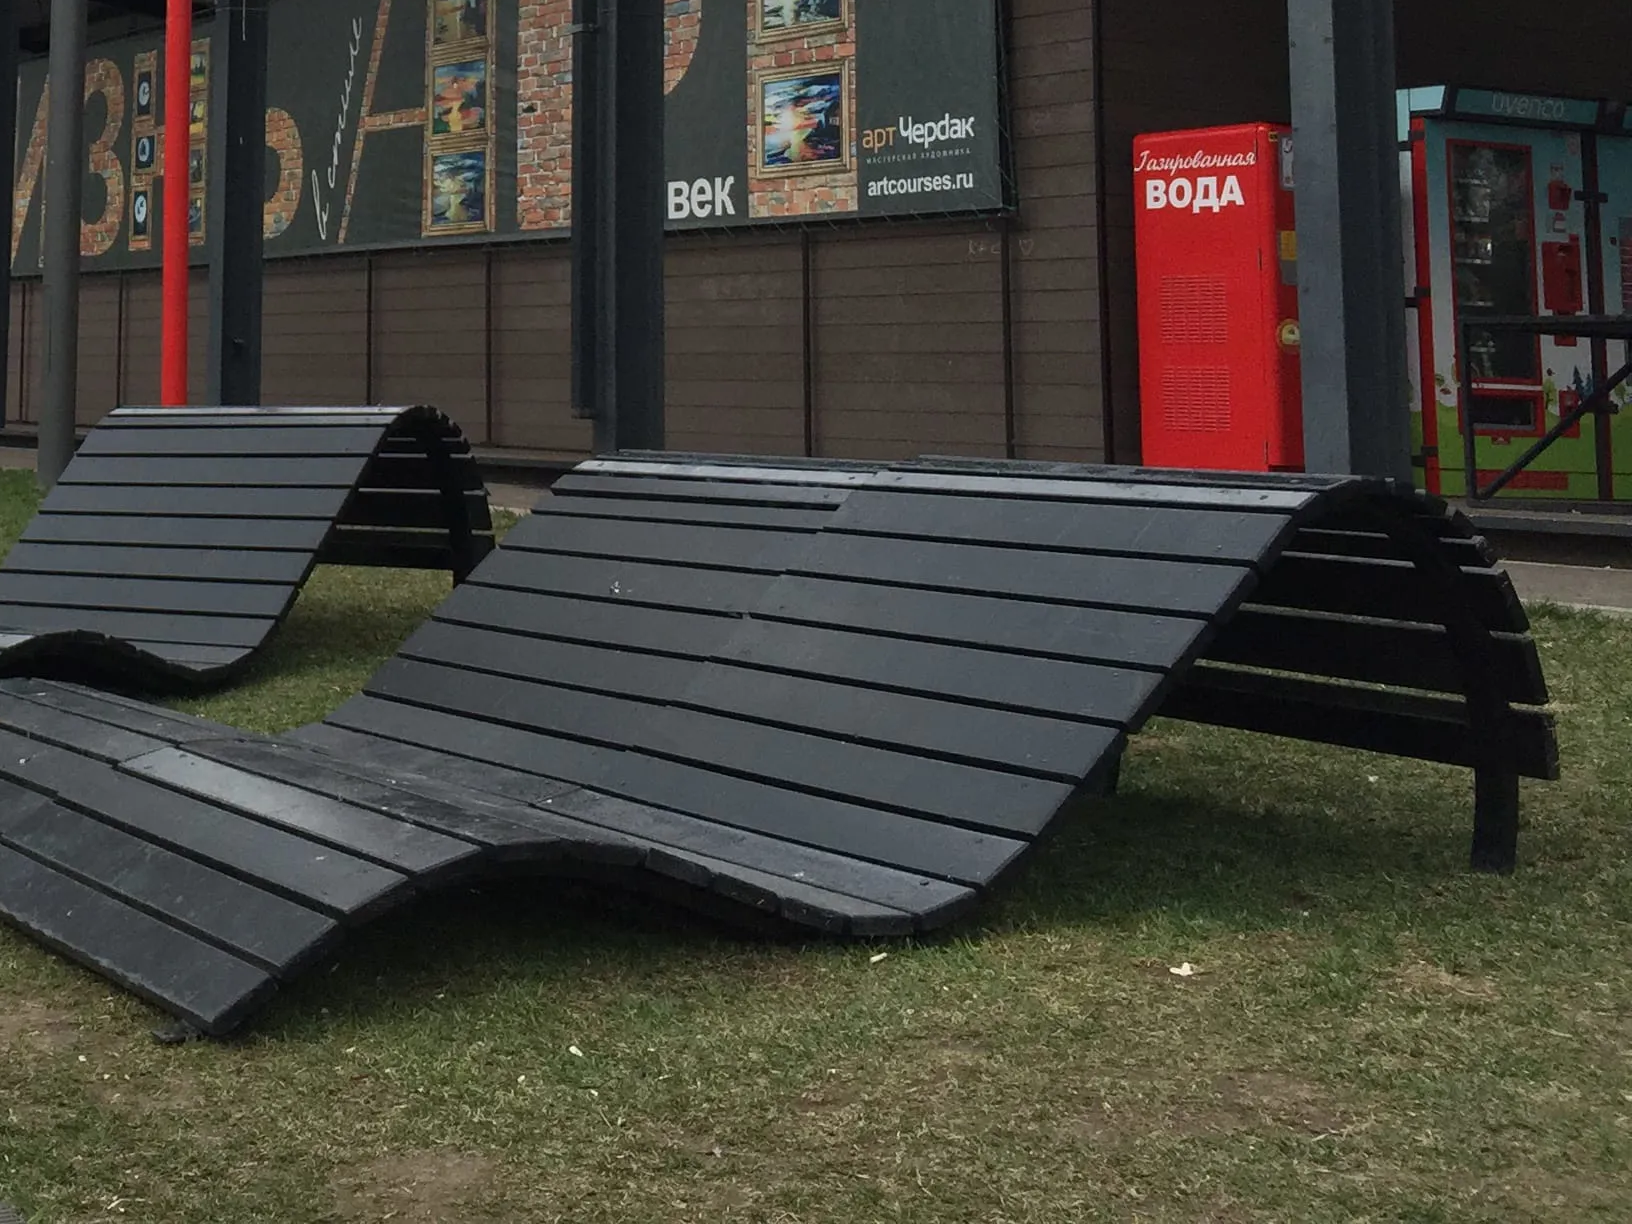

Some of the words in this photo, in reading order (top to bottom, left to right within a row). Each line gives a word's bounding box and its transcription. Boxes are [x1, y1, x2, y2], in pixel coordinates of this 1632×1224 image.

[862, 126, 897, 154] арт
[898, 112, 976, 150] Чердак
[1134, 149, 1257, 177] Газированная
[868, 172, 974, 197] artcourses.ru
[1146, 175, 1245, 214] ВОДА
